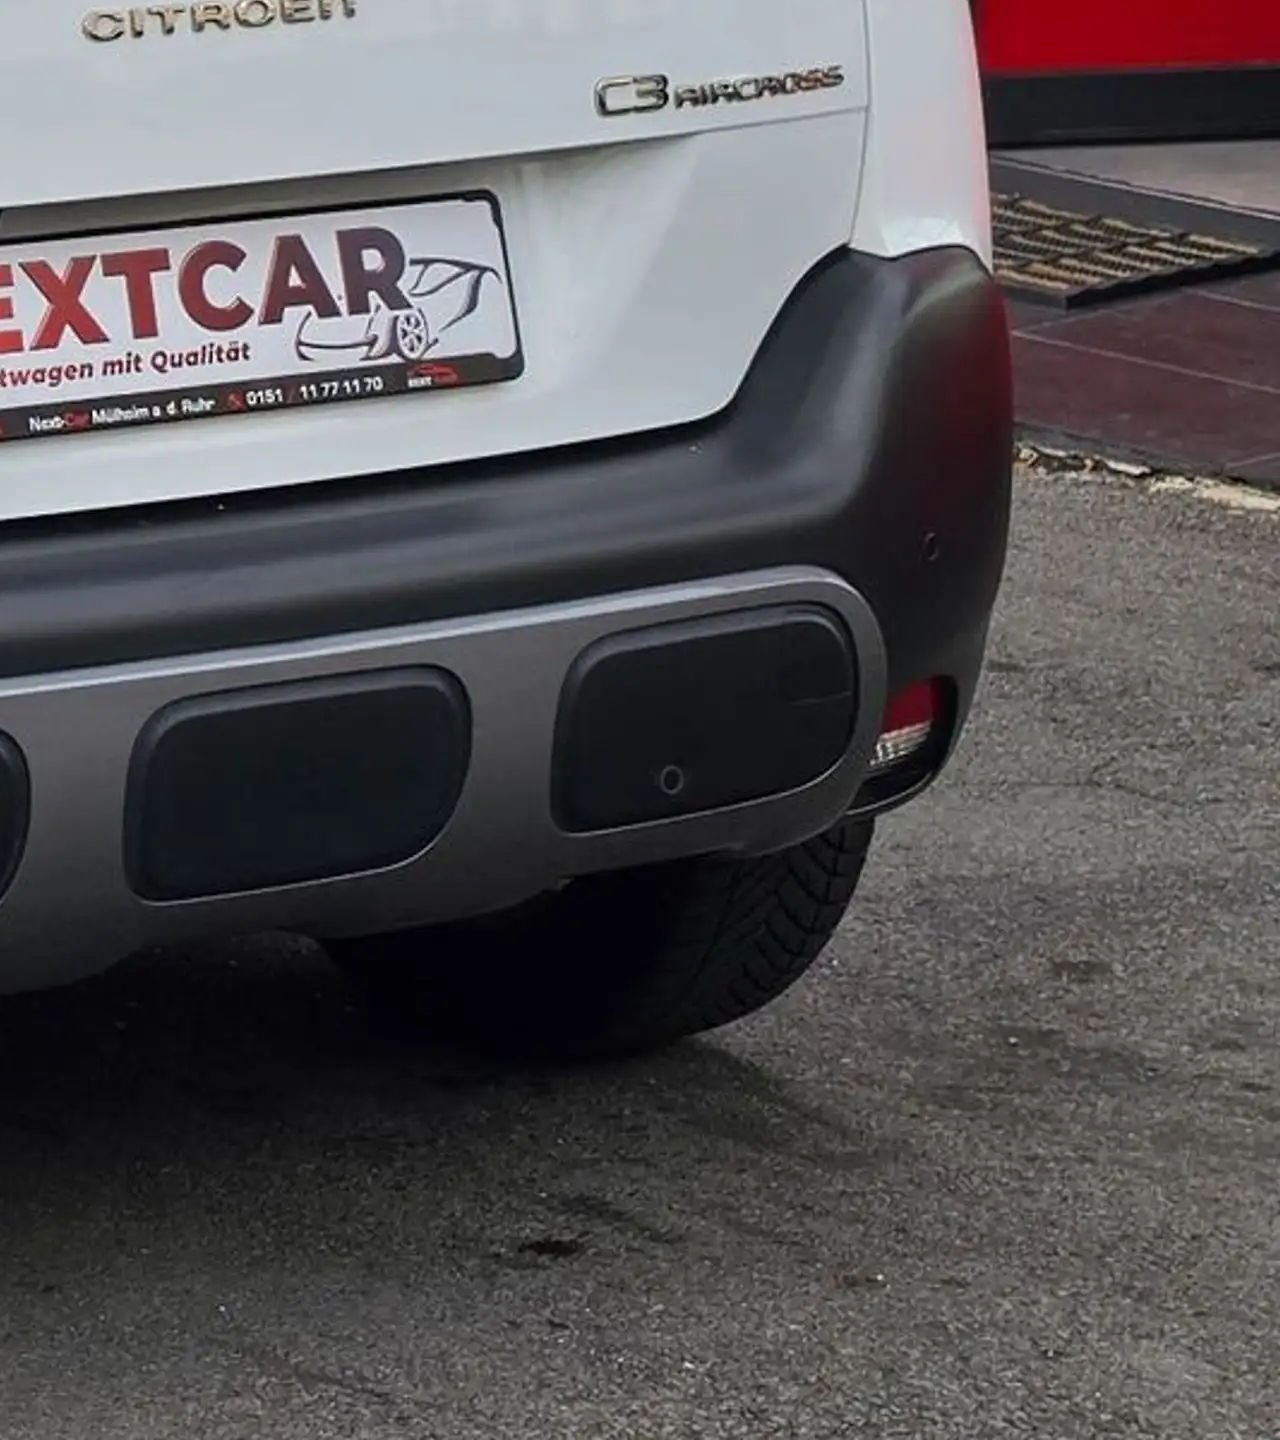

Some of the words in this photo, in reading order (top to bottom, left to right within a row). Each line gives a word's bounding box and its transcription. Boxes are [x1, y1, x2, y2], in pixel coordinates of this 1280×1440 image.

[594, 73, 670, 117] C3
[673, 65, 845, 109] AIRCROSS
[101, 351, 144, 377] mit
[152, 341, 250, 374] Qualität
[245, 388, 284, 407] 0151
